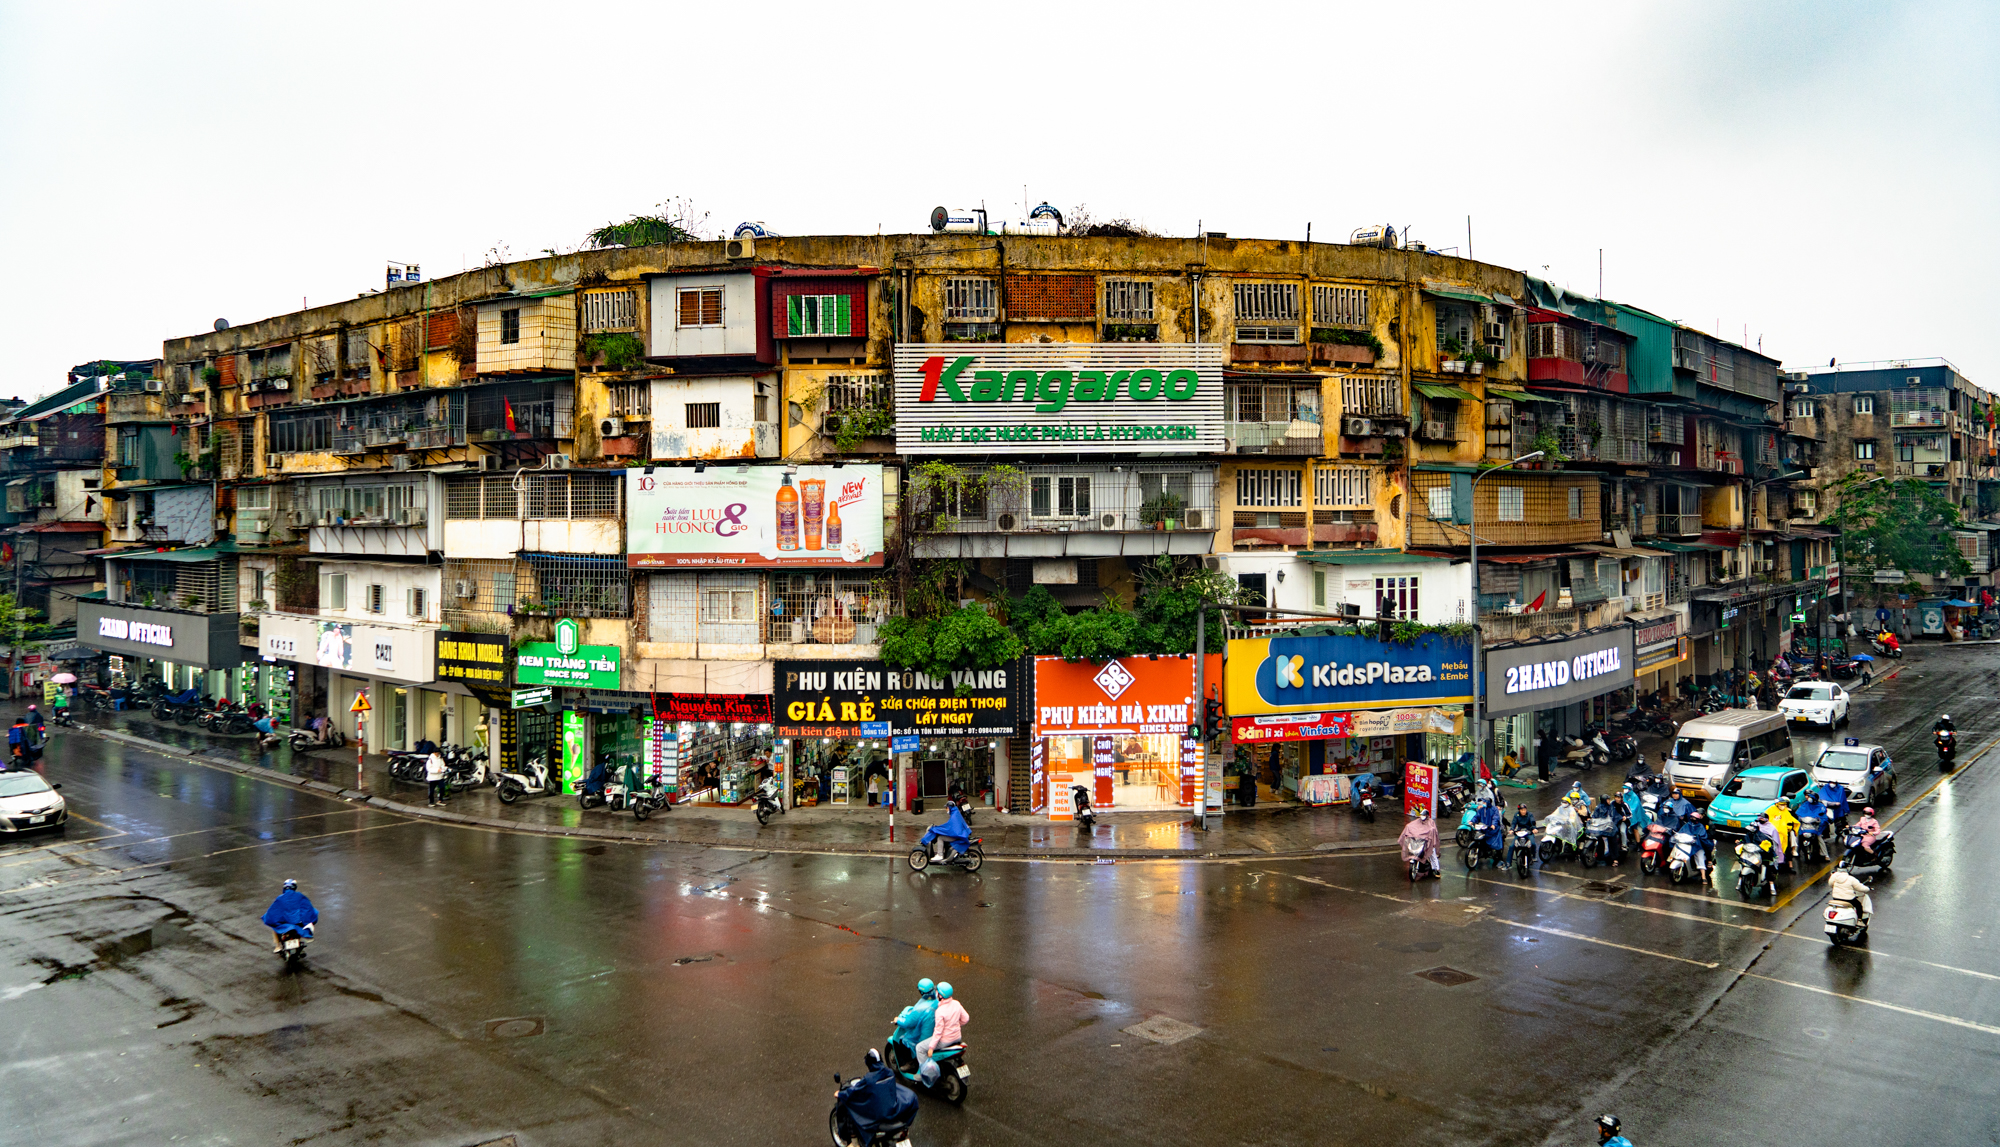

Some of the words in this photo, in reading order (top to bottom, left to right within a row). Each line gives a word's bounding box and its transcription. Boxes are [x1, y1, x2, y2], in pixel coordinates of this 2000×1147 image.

[921, 423, 956, 441] MÁY
[961, 427, 991, 444] LỌC
[996, 423, 1038, 441] NƯỚC
[1042, 421, 1078, 440] PHẢI
[1083, 422, 1104, 440] LÀ
[1110, 425, 1197, 440] HYDROGEN
[842, 477, 866, 496] NEW
[655, 521, 715, 534] HƯƠNG
[715, 503, 747, 537] 8
[692, 508, 722, 521] LƯU
[691, 557, 707, 566] NHẬP
[99, 616, 129, 640] 2HAND
[129, 620, 174, 647] OFFICIAL
[438, 637, 457, 660] ĐĂNG
[458, 641, 476, 661] KHOA
[477, 643, 504, 664] MOBILE
[518, 655, 544, 668] KEM
[546, 654, 586, 670] TRÀNG
[589, 654, 616, 672] TIỀN
[1441, 662, 1453, 671] Mẹ
[1453, 660, 1468, 670] bầu
[1505, 660, 1570, 694] 2HAND
[1572, 646, 1621, 681] OFFICIAL
[544, 669, 570, 679] SINCE
[571, 671, 590, 680] 1958
[833, 666, 881, 695] KIỆN
[1312, 661, 1432, 687] KidsPlaza
[725, 701, 752, 713] Kim
[787, 696, 836, 721] GIÁ
[840, 695, 876, 721] RẺ
[880, 695, 903, 710] SỬA
[905, 696, 937, 710] CHỮA
[939, 698, 967, 711] ĐIỆN
[970, 697, 1007, 711] THOẠI
[916, 711, 938, 725] LẤY
[941, 713, 974, 725] NGAY
[1040, 706, 1074, 729] PHỤ
[1078, 701, 1117, 729] KIỆN
[1121, 700, 1144, 723] HÀ
[1147, 704, 1188, 723] XINH
[903, 726, 912, 735] SỐ
[921, 727, 932, 735] TÔN
[933, 726, 947, 735] THẤT
[1140, 724, 1167, 733] SINCE
[1169, 724, 1188, 733] 2011
[1237, 725, 1264, 740] Săn
[1265, 727, 1272, 738] lì
[1273, 727, 1284, 738] xì
[1299, 724, 1340, 737] Vinfast
[1096, 752, 1111, 763] CÔNG
[1096, 765, 1112, 778] NGHỆ
[1409, 765, 1427, 776] Săn
[1407, 786, 1430, 798] Vinfast
